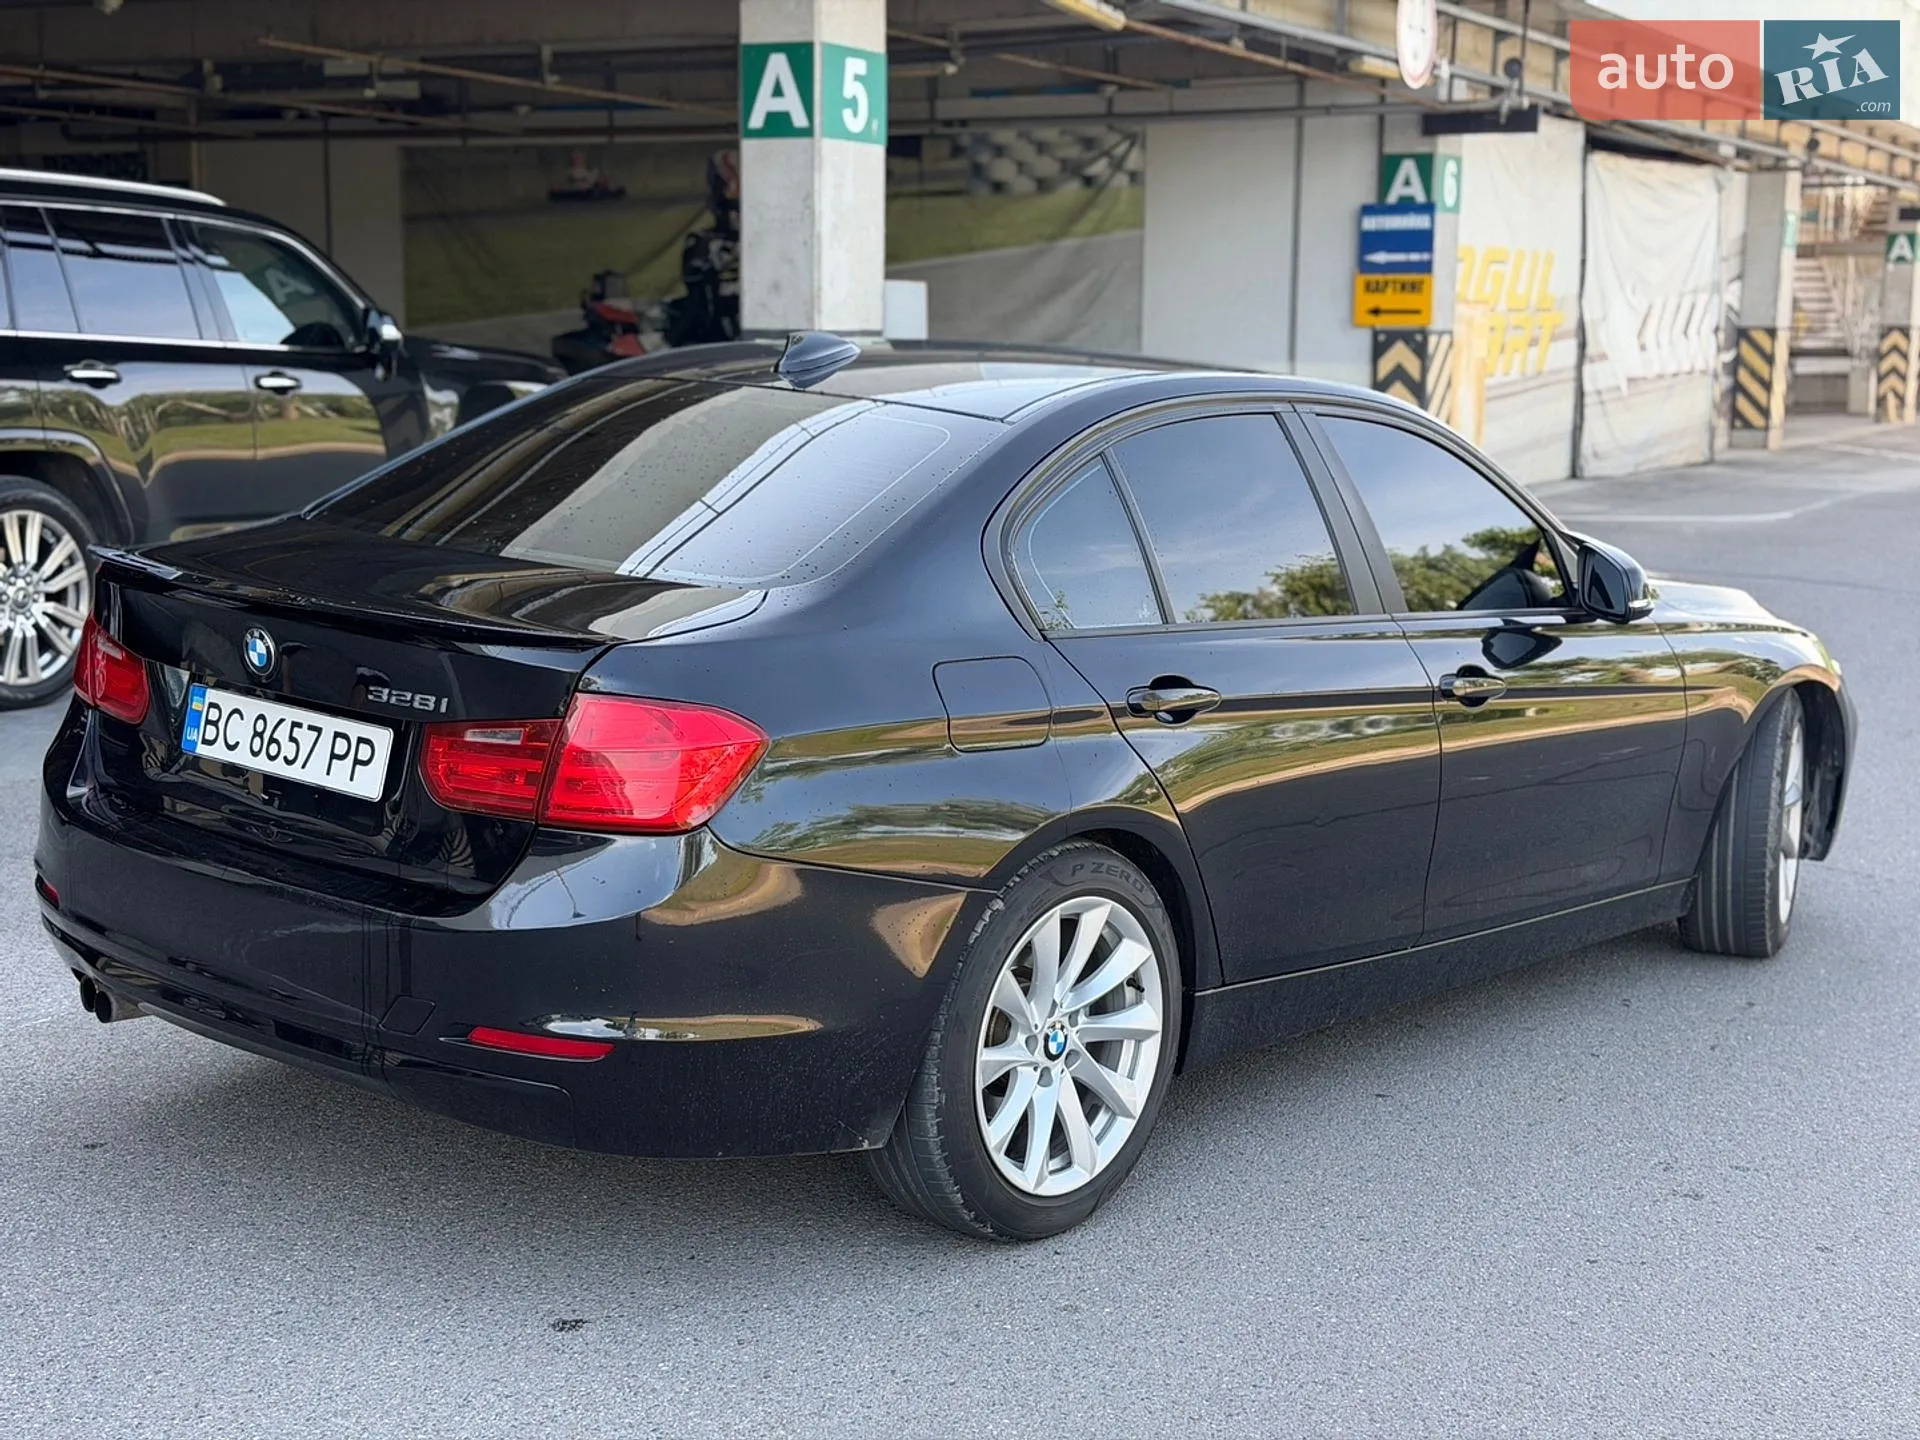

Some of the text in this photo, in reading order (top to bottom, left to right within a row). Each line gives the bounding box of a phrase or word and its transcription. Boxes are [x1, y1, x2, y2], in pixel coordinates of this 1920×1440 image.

[748, 52, 810, 129] A
[842, 56, 869, 133] 5
[1385, 157, 1428, 205] A
[1443, 158, 1458, 208] 6
[1888, 233, 1914, 262] A
[186, 726, 199, 743] UA
[201, 701, 376, 782] BC 8657 PP
[1090, 861, 1147, 894] ZERO
